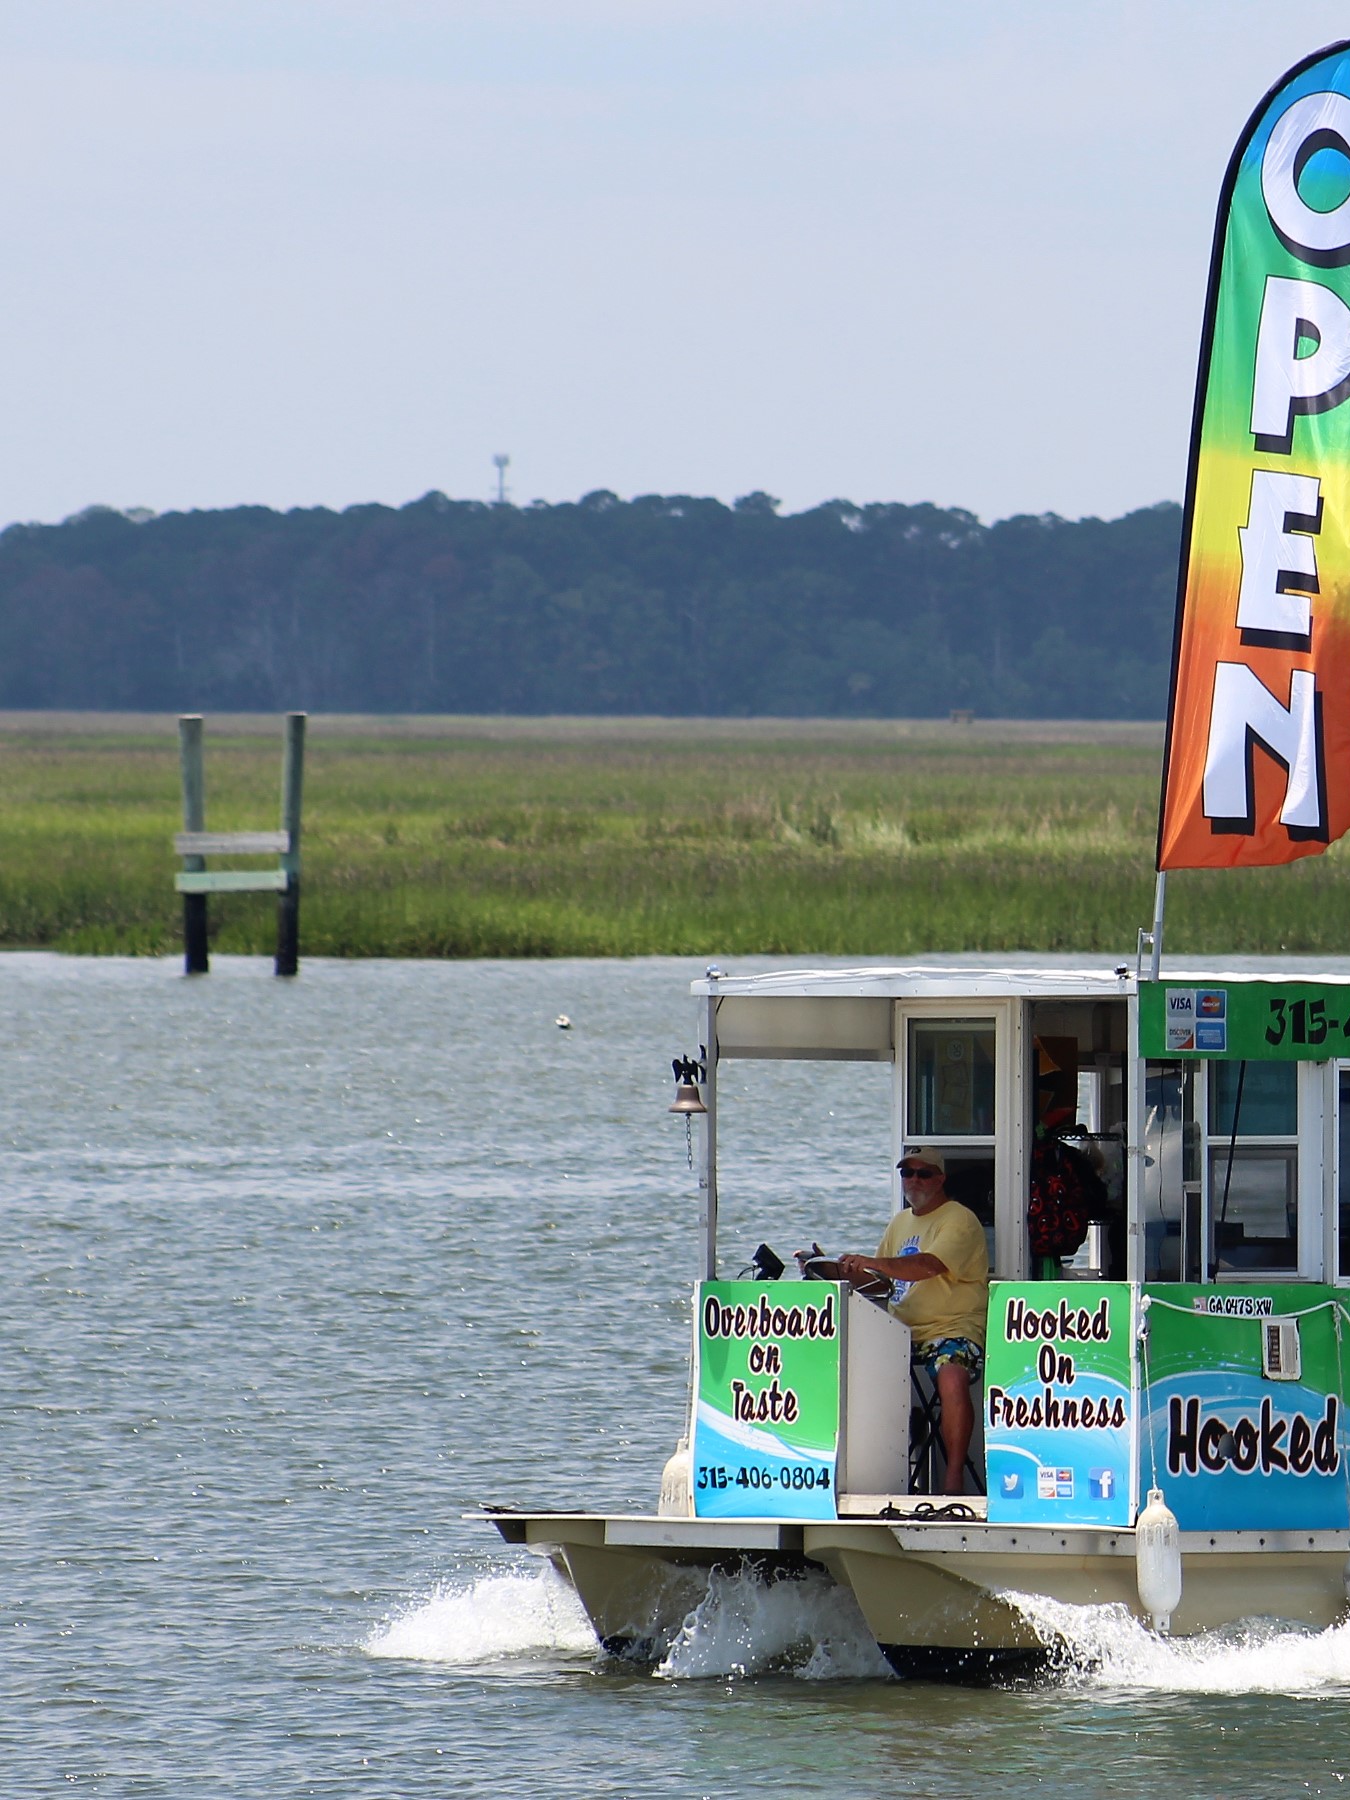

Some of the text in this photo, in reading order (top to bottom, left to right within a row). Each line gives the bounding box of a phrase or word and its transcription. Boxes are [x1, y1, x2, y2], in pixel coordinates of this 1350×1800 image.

[1170, 997, 1192, 1010] VISA
[704, 1294, 836, 1339] Overboard
[1006, 1298, 1110, 1341] Hooked
[1208, 1297, 1223, 1313] GA
[1256, 1299, 1273, 1316] XW
[749, 1343, 782, 1375] on
[1039, 1344, 1075, 1385] On
[732, 1379, 799, 1423] Taste
[989, 1387, 1127, 1429] Freshness
[1168, 1394, 1341, 1477] Hooked
[697, 1466, 831, 1491] 315-406-0804
[1039, 1471, 1054, 1479] VISA
